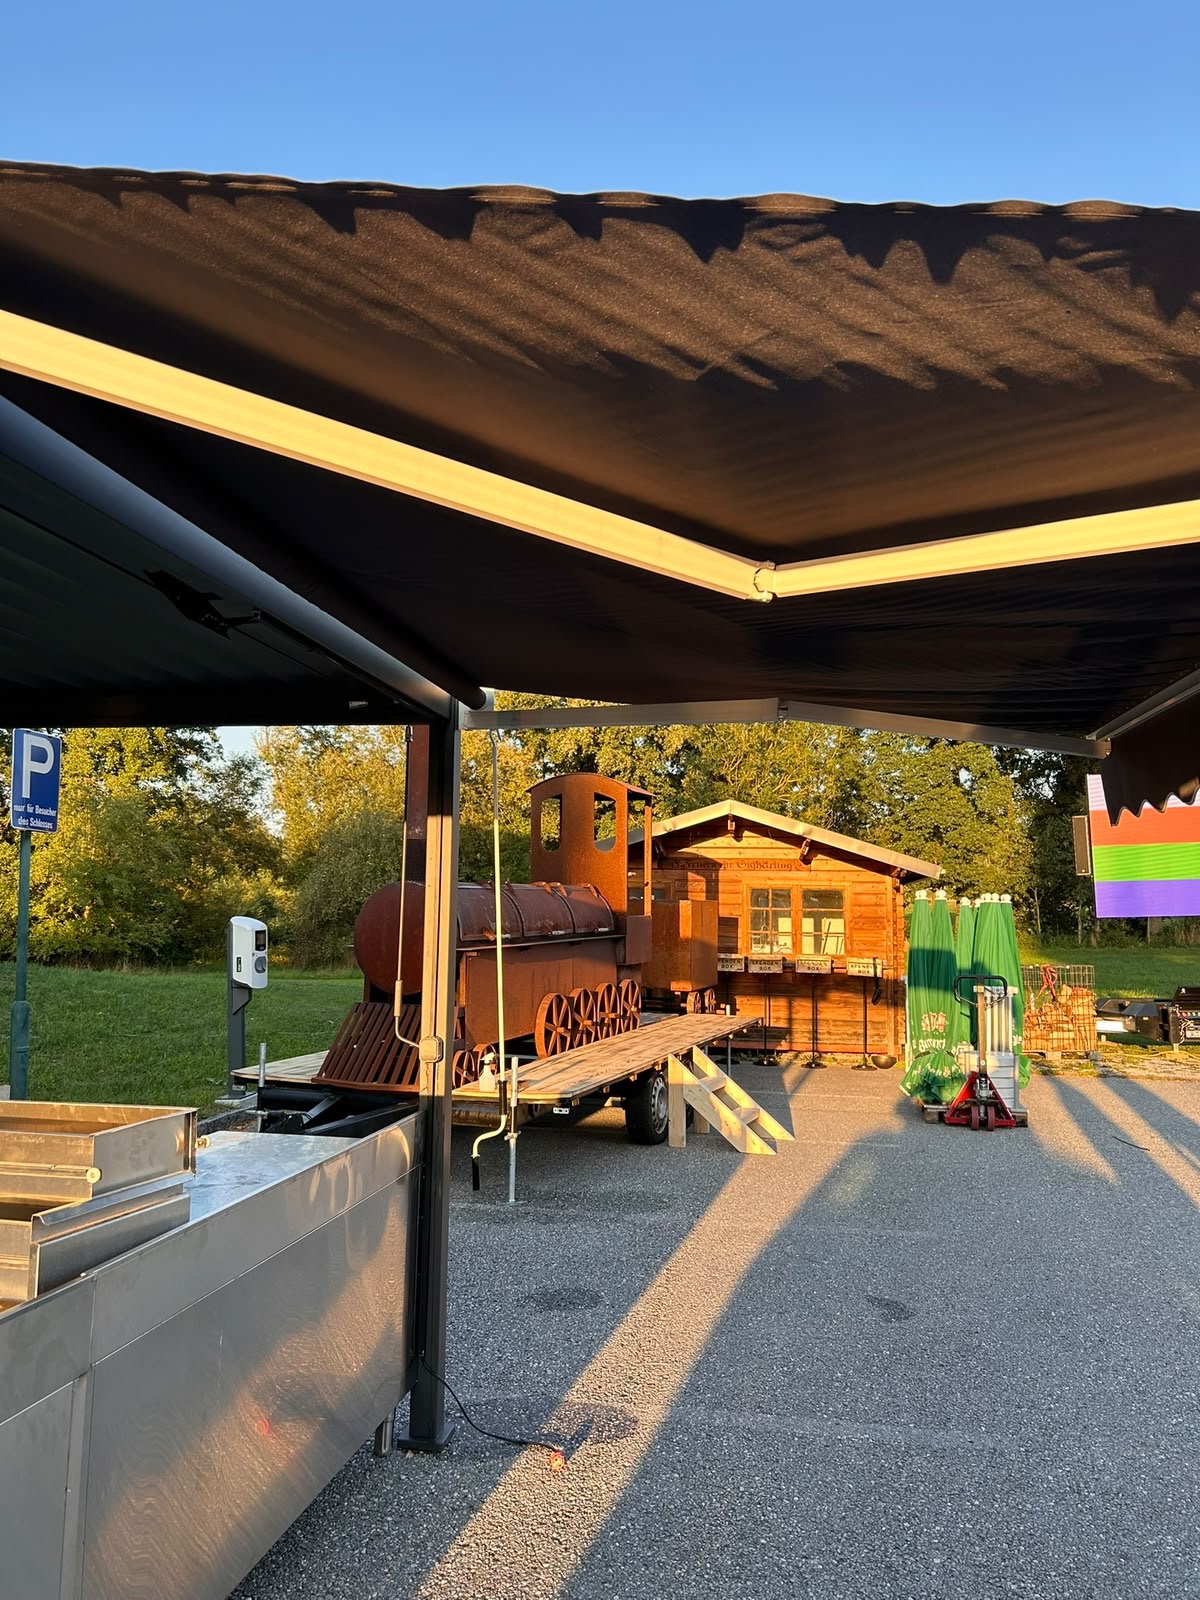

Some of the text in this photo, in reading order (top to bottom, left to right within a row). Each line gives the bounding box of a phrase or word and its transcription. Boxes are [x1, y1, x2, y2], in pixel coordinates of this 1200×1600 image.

[22, 734, 54, 798] P
[14, 803, 57, 816] nur für Besucher
[18, 816, 53, 829] des Schlosses
